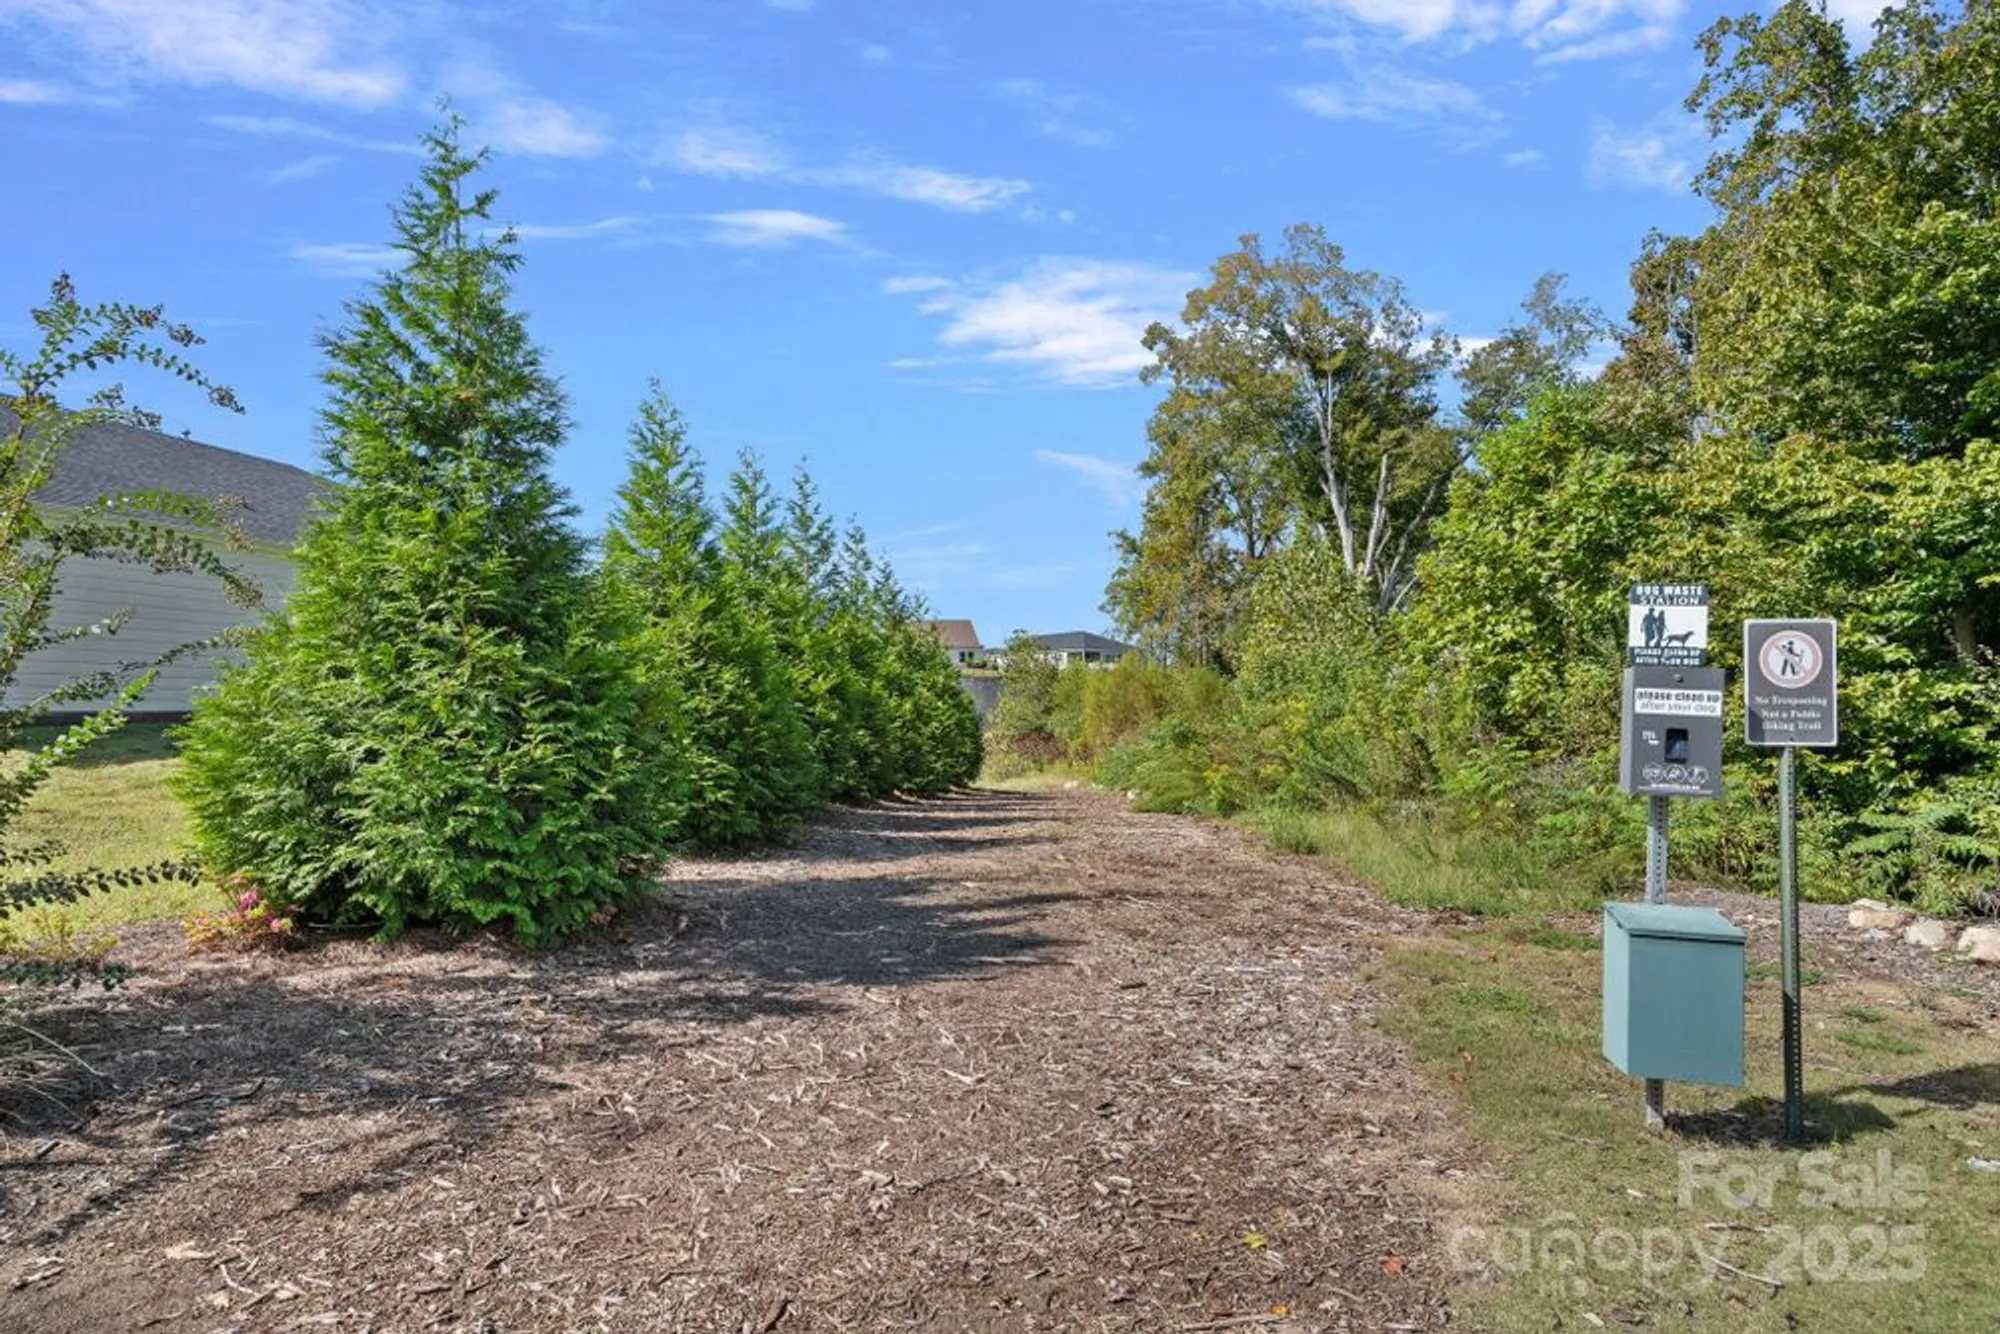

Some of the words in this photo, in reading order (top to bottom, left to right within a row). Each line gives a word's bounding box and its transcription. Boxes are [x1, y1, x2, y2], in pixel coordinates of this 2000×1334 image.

[1663, 585, 1702, 595] WASTE
[1640, 596, 1700, 606] STATION
[1637, 689, 1673, 701] please
[1675, 692, 1705, 702] clean
[1706, 694, 1720, 703] up
[1755, 695, 1769, 705] No
[1771, 695, 1828, 707] Trespassing
[1640, 701, 1665, 710] after
[1694, 703, 1716, 713] dog
[1762, 709, 1779, 719] Not
[1790, 709, 1822, 719] Public
[1762, 720, 1795, 732] Hiking
[1797, 720, 1822, 730] Trail
